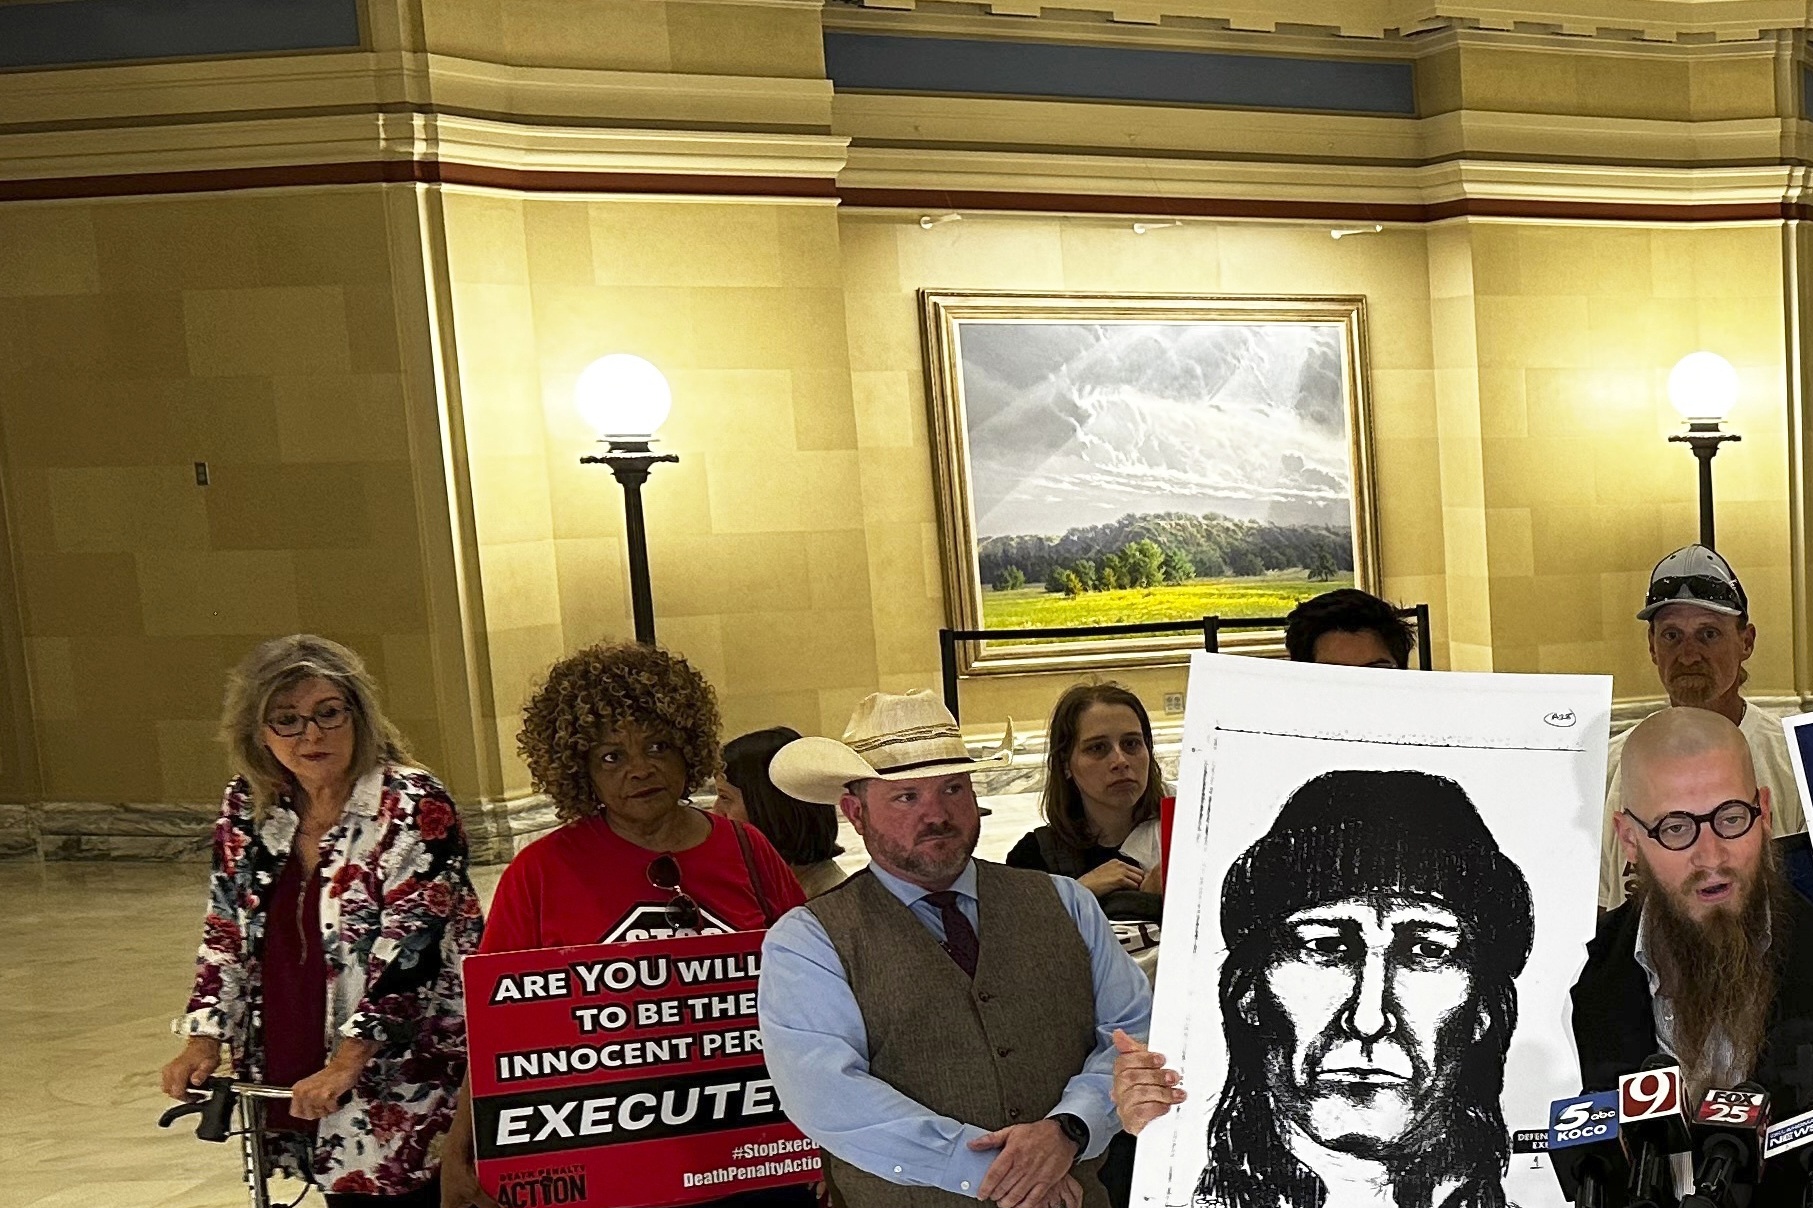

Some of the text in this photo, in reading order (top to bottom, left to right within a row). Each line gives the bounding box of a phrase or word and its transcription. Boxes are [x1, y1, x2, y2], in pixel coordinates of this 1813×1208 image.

[495, 955, 760, 1001] ARE YOU WILL
[576, 993, 756, 1031] TO BE THE
[500, 1030, 763, 1079] INNOCENT PER
[1629, 1071, 1671, 1115] 9
[1713, 1091, 1757, 1106] FOX
[496, 1079, 783, 1145] EXECUTE
[1554, 1101, 1616, 1131] 5 abc
[1706, 1104, 1751, 1123] 25
[1518, 1132, 1548, 1141] DEFEN
[1557, 1124, 1607, 1142] KOCO
[732, 1138, 820, 1160] #StopExecu
[683, 1156, 822, 1188] DeathPenaltyActio
